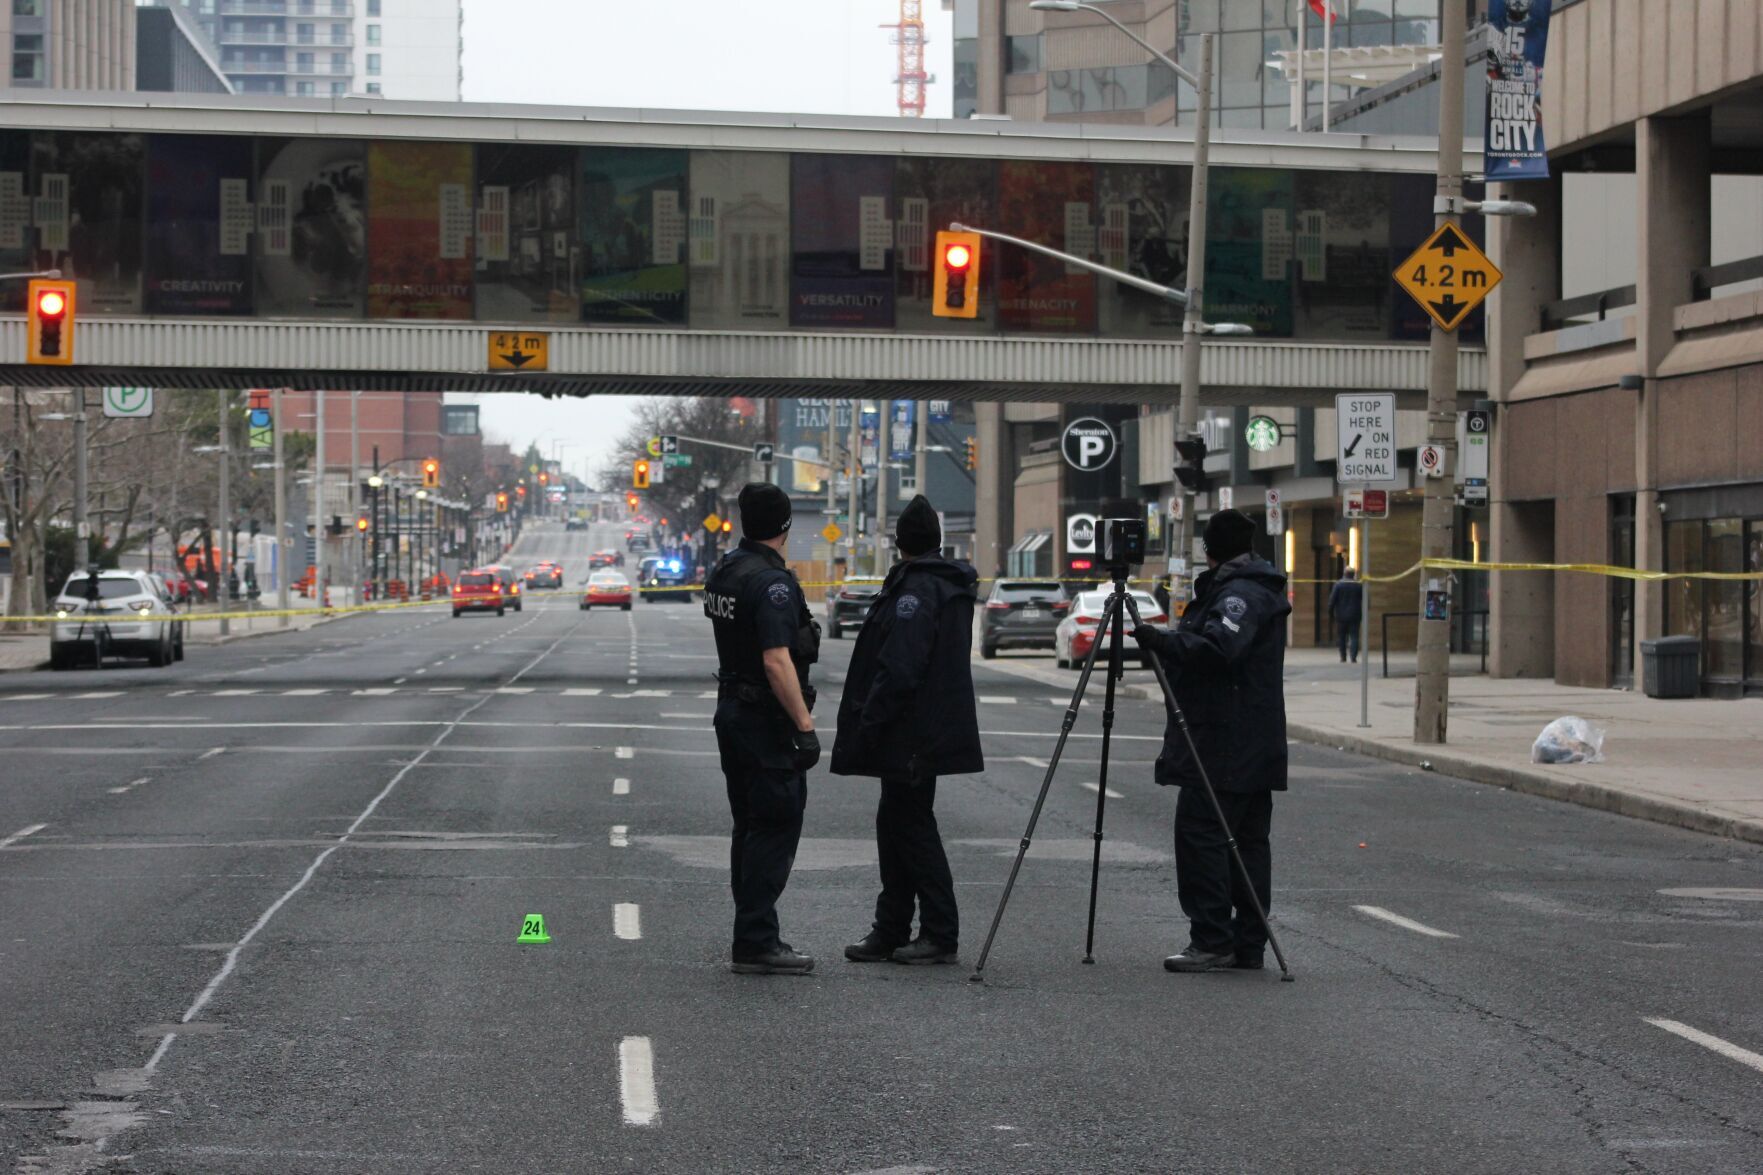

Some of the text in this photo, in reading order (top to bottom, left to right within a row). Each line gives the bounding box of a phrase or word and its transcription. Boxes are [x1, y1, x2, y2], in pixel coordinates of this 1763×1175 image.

[1504, 26, 1525, 55] 15
[1491, 80, 1535, 95] WELCOME TO
[1490, 92, 1536, 120] ROCK
[1490, 119, 1537, 151] CITY
[1412, 265, 1486, 287] 4.2 m
[160, 280, 244, 293] CREATIVITY
[376, 283, 468, 297] TRANQUILITY
[800, 294, 884, 307] VERSATILITY
[1012, 298, 1078, 311] TENACITY
[1209, 304, 1277, 316] HARMONY
[525, 337, 540, 349] m
[1351, 401, 1380, 412] STOP
[1349, 417, 1382, 428] HERE
[1070, 428, 1109, 436] Sheraton
[1373, 433, 1389, 443] ON
[1080, 436, 1105, 467] P
[1365, 449, 1389, 459] RED
[1345, 464, 1389, 475] SIGNAL
[1071, 526, 1094, 539] Levity
[703, 592, 736, 620] POLICE
[524, 920, 540, 935] 24
